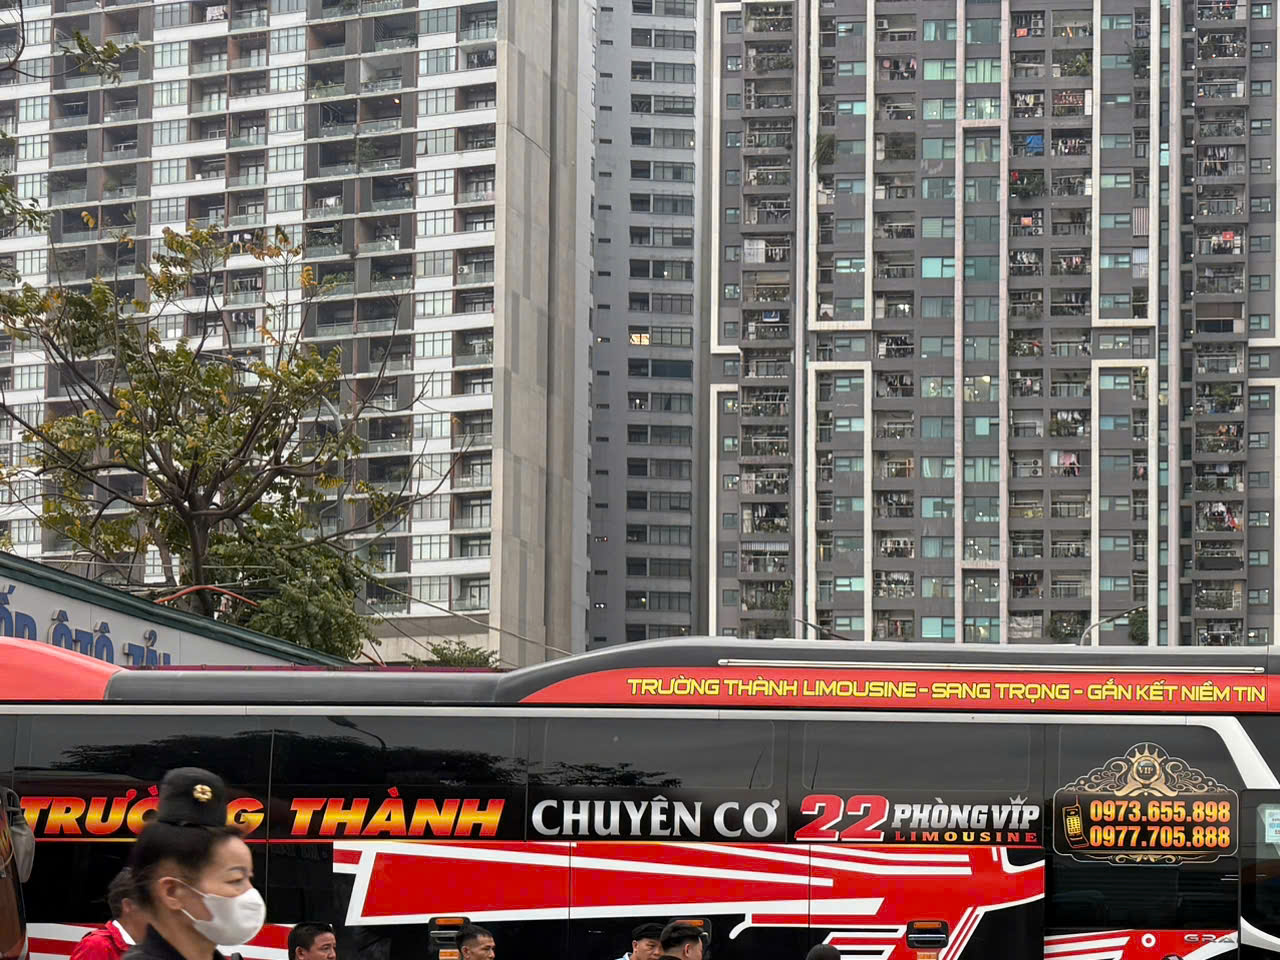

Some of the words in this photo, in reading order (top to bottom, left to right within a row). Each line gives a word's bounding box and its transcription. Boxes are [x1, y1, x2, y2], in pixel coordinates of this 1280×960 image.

[627, 676, 720, 695] TRƯỜNG
[724, 676, 798, 696] THÀNH
[803, 679, 917, 698] LIMOUSINE
[931, 682, 991, 699] SANG
[995, 683, 1070, 703] TRỌNG
[1087, 678, 1132, 700] GẮN
[1136, 680, 1178, 701] KẾT
[1181, 680, 1231, 702] NIỀM
[1233, 684, 1266, 702] TIN
[1138, 766, 1153, 775] VIP
[290, 786, 506, 836] THÀNH
[532, 795, 701, 837] CHUYÊN
[713, 799, 781, 838] CƠ
[794, 794, 889, 841] 22
[891, 796, 988, 829] PHÒNG
[992, 803, 1040, 830] VIP
[1089, 800, 1231, 822] 0973.655.898
[895, 831, 1038, 842] LIMOUSINE
[1089, 825, 1231, 848] 0977.705.888
